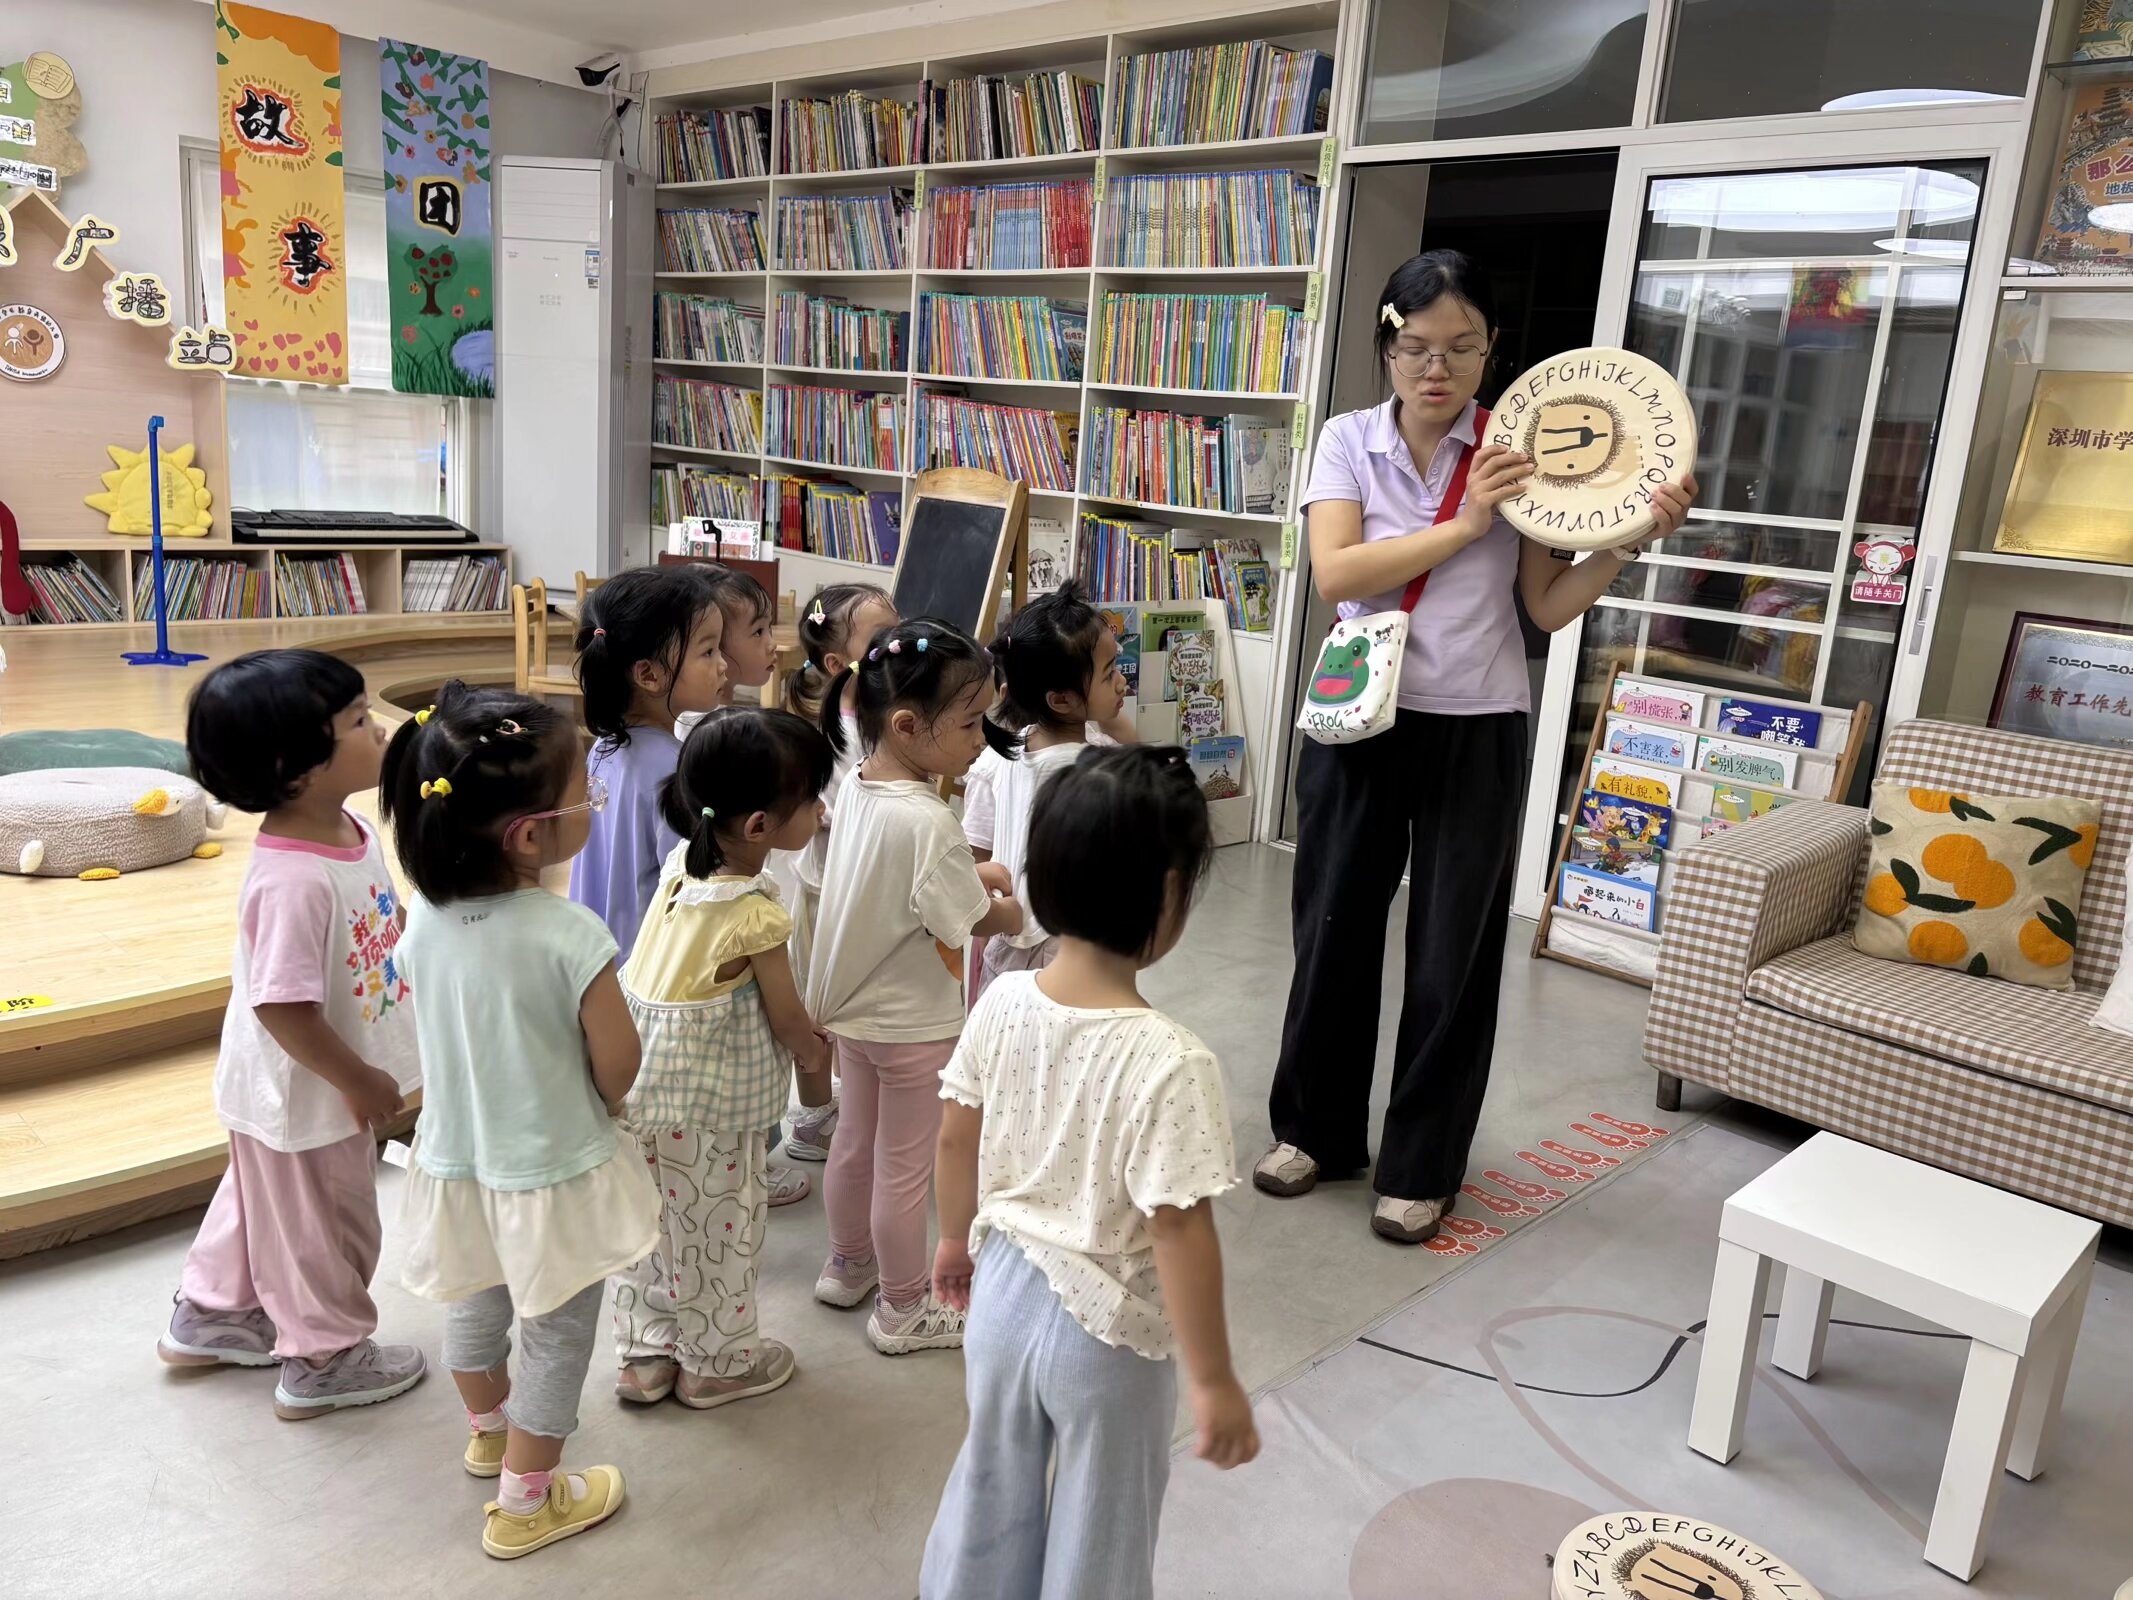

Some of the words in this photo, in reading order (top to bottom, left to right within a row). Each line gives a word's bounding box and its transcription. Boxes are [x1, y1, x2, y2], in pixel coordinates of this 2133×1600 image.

[236, 89, 332, 287] 故事
[2047, 427, 2133, 451] 深圳市学
[1855, 585, 1902, 600] 请随手关门
[2024, 683, 2132, 718] 教育工作先
[1311, 709, 1345, 733] FROG
[1771, 716, 1801, 733] 不要
[1760, 729, 1806, 748] 嘲笑我
